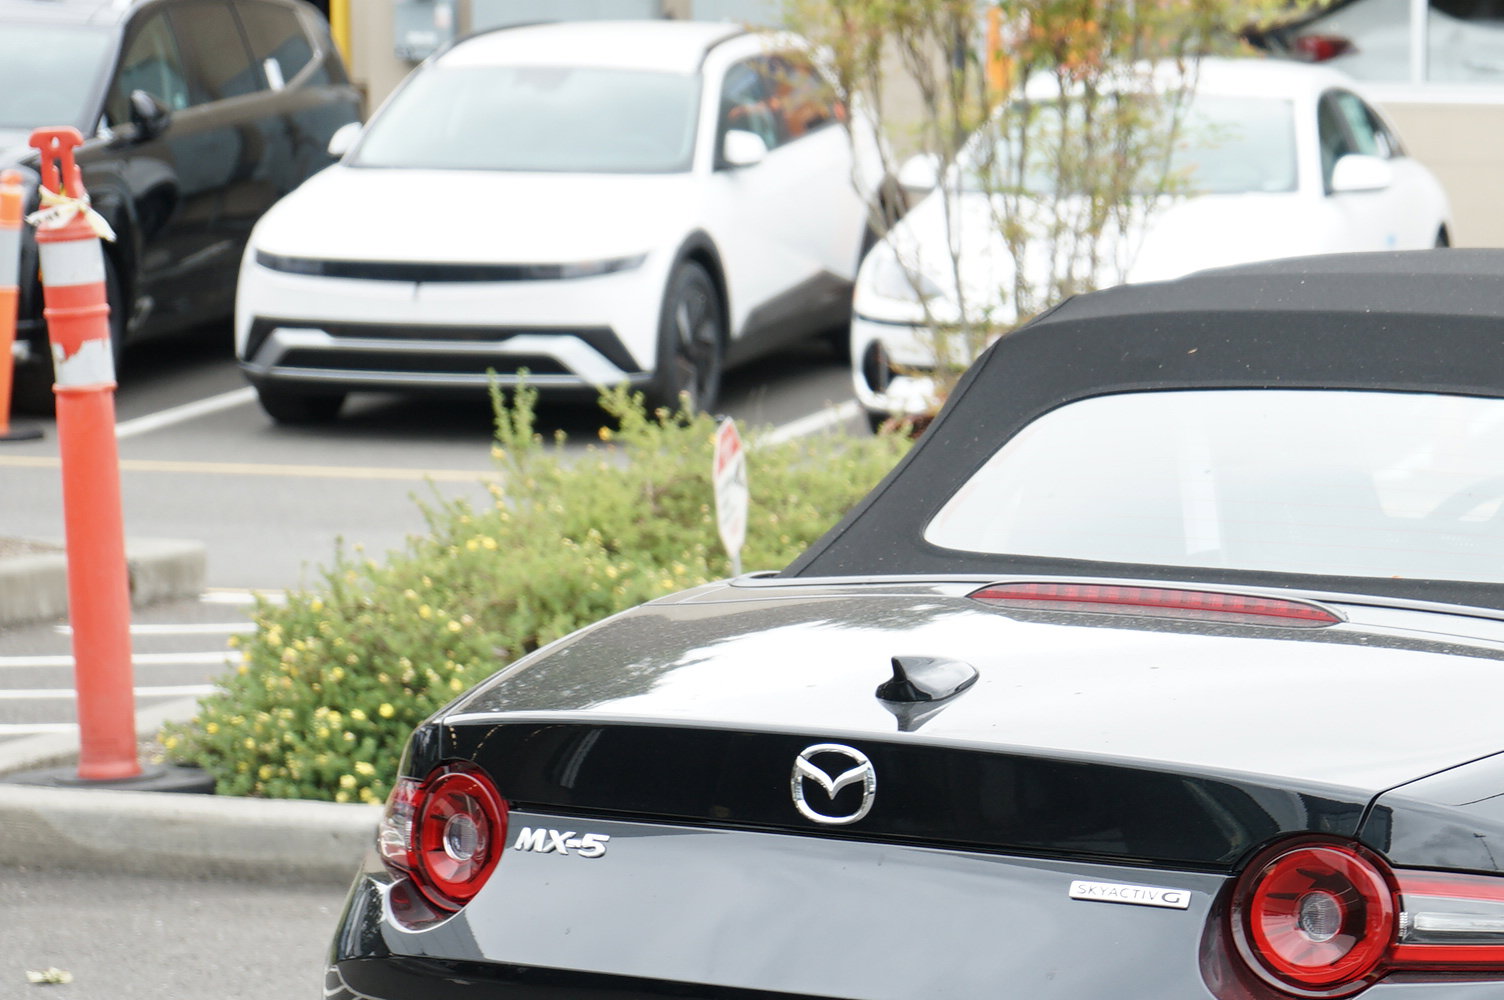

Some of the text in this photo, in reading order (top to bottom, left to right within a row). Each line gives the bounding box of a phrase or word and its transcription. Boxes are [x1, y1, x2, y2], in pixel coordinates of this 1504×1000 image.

[514, 827, 610, 858] MX-5
[1078, 884, 1182, 904] SKYACTIV G
